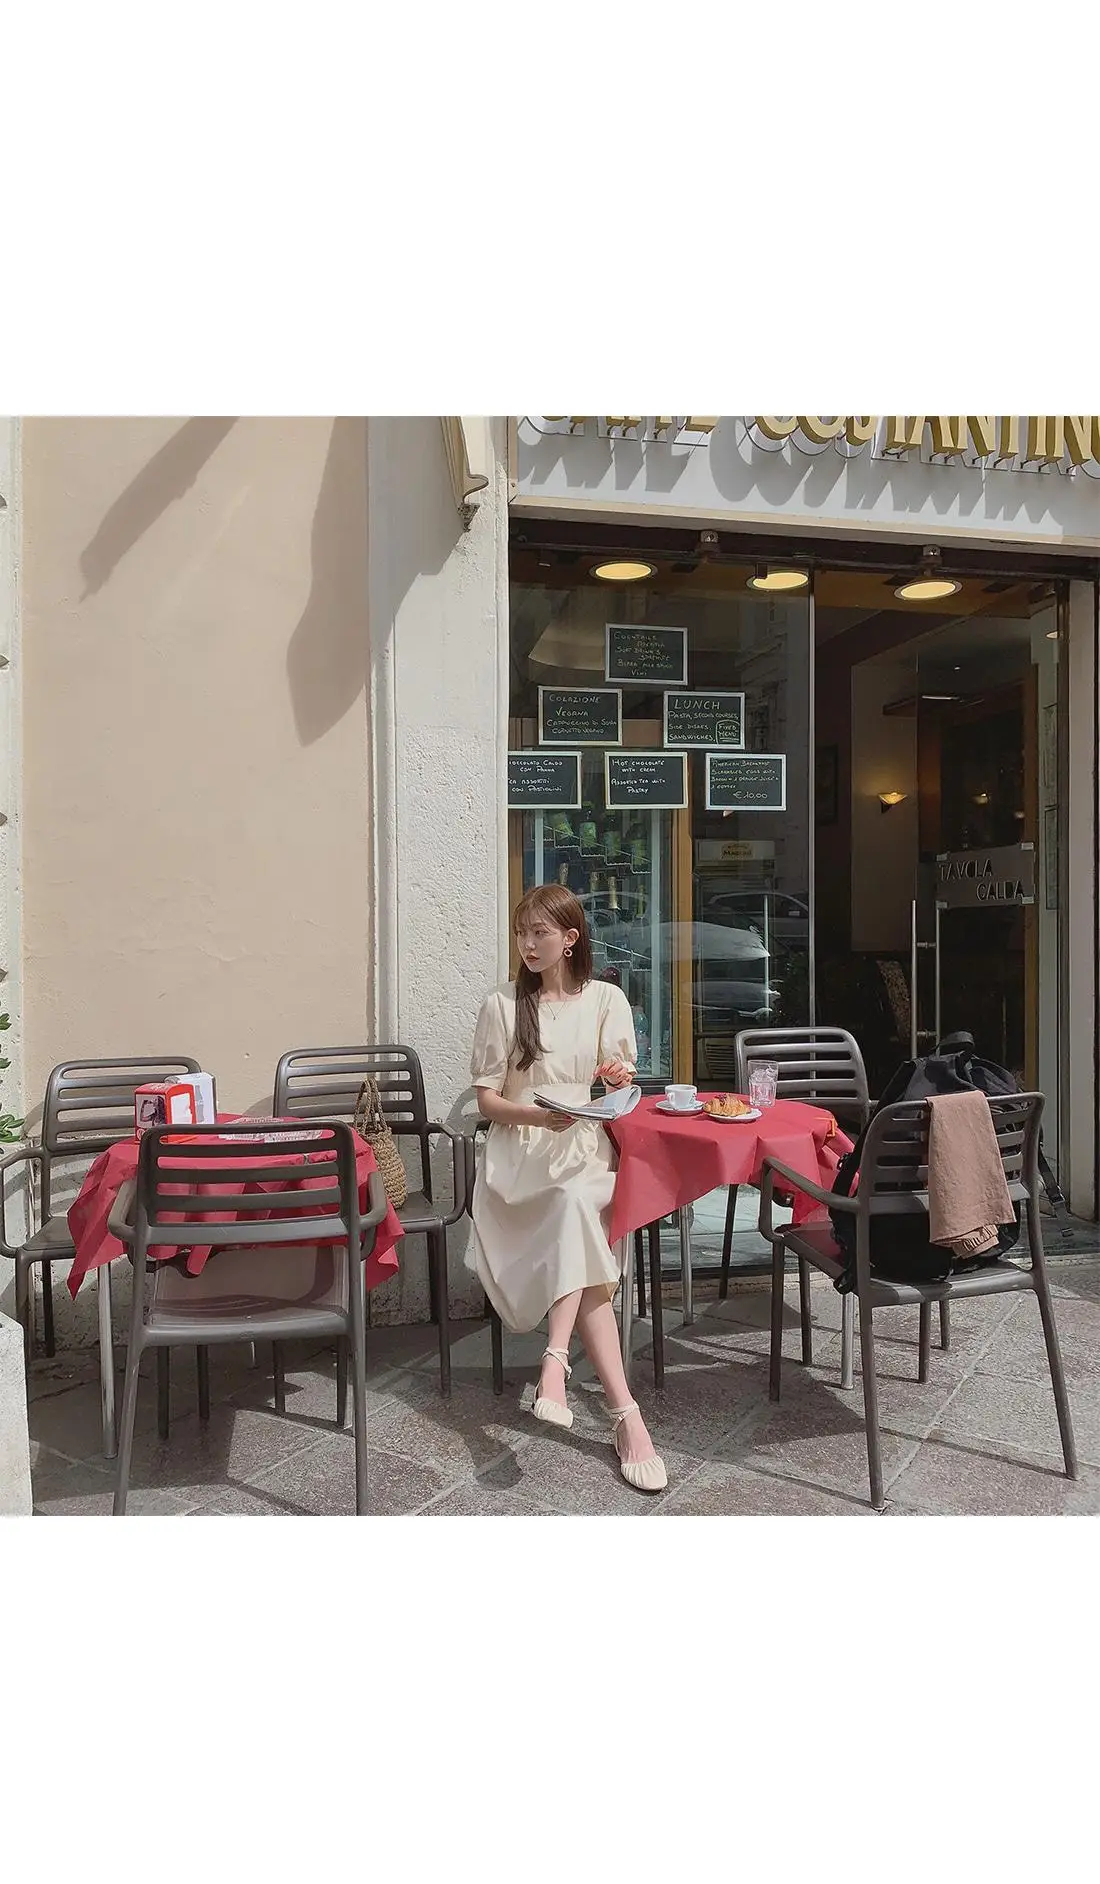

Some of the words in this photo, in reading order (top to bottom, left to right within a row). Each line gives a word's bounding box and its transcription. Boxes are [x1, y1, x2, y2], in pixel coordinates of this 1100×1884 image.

[549, 694, 600, 704] COLAZIONE
[674, 699, 720, 709] LUNCH
[556, 707, 589, 717] VEGANA
